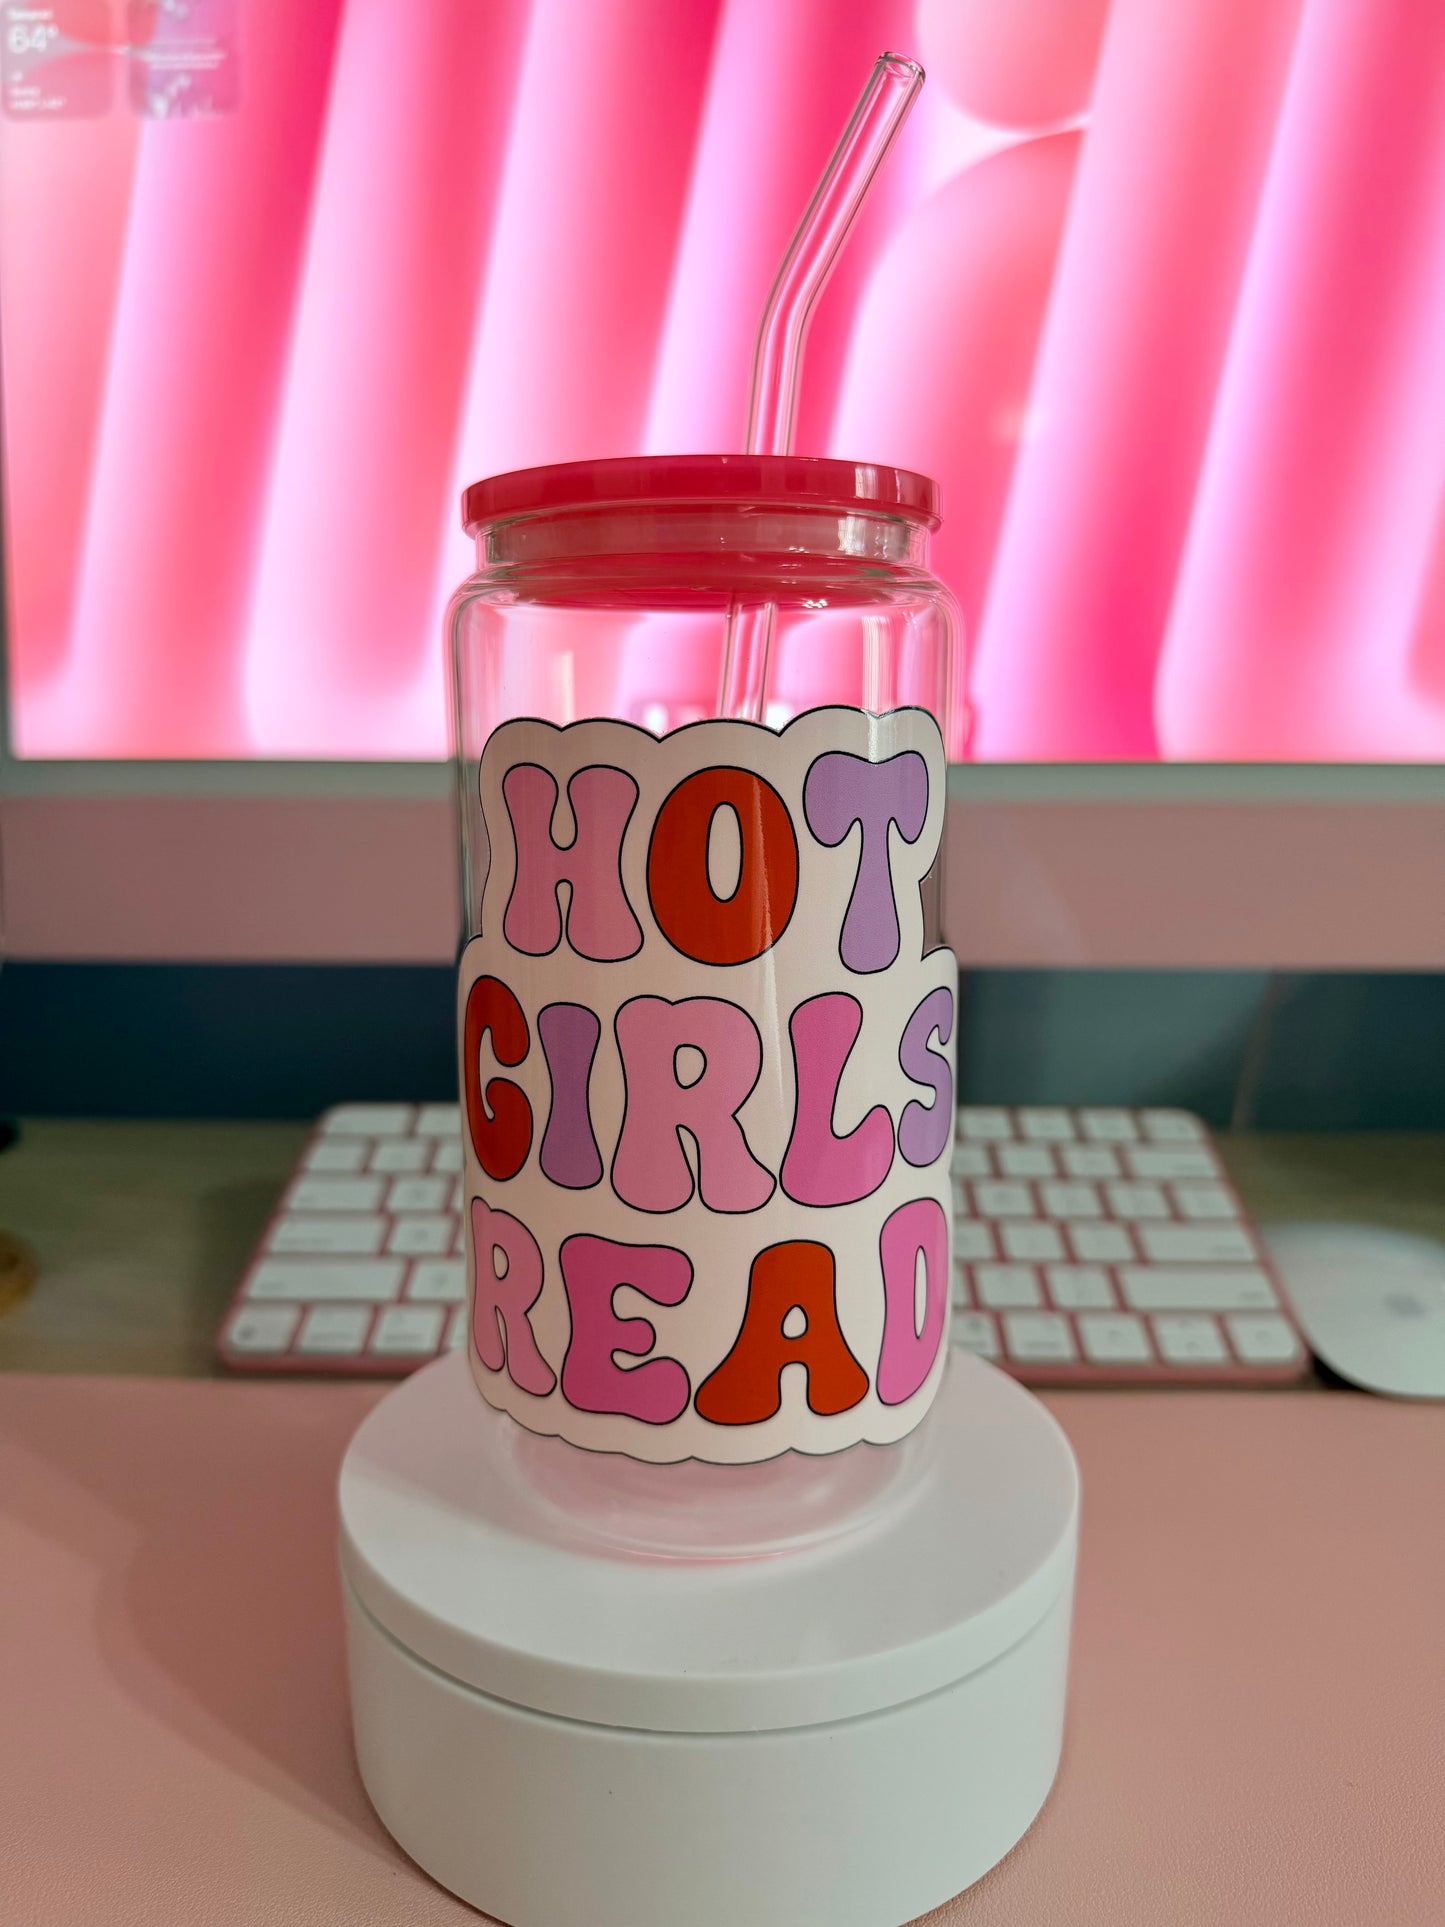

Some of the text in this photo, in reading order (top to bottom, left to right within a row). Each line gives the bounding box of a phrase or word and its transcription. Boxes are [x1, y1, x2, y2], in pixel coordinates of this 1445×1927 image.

[502, 750, 929, 975] HOT
[464, 975, 953, 1214] GIRLS
[470, 1196, 949, 1425] READ
